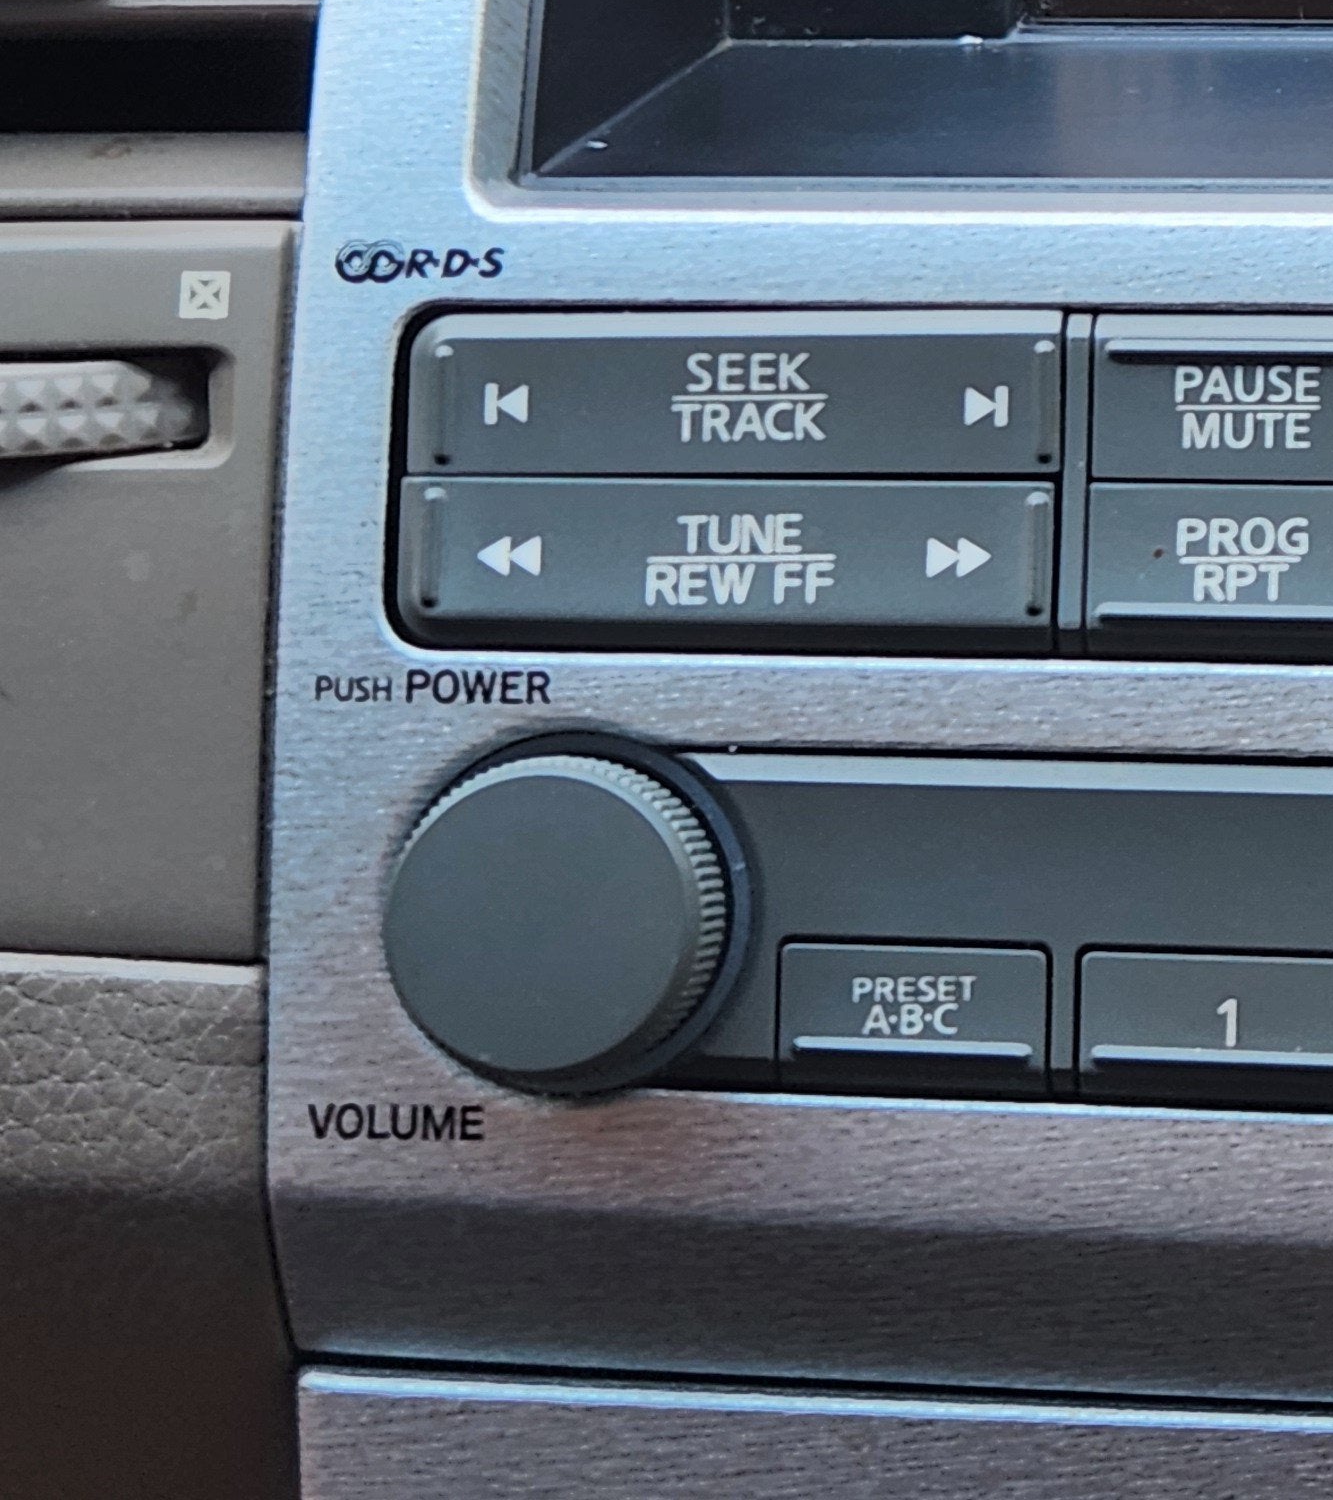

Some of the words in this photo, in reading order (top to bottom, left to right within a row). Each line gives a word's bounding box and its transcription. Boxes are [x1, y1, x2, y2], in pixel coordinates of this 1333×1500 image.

[686, 353, 811, 392] SEEK
[1174, 366, 1321, 404] PAUSE
[671, 402, 827, 442] TRACK
[1181, 413, 1312, 449] MUTE
[677, 514, 804, 555] TUNE
[1175, 518, 1310, 557] PROG
[645, 564, 755, 606] REW
[772, 563, 835, 604] FF
[1193, 563, 1289, 602] RPT
[314, 674, 392, 702] PUSH
[405, 669, 552, 704] POWER
[851, 975, 977, 1003] PRESET
[1217, 997, 1238, 1047] 1
[305, 1104, 484, 1141] VOLUME
